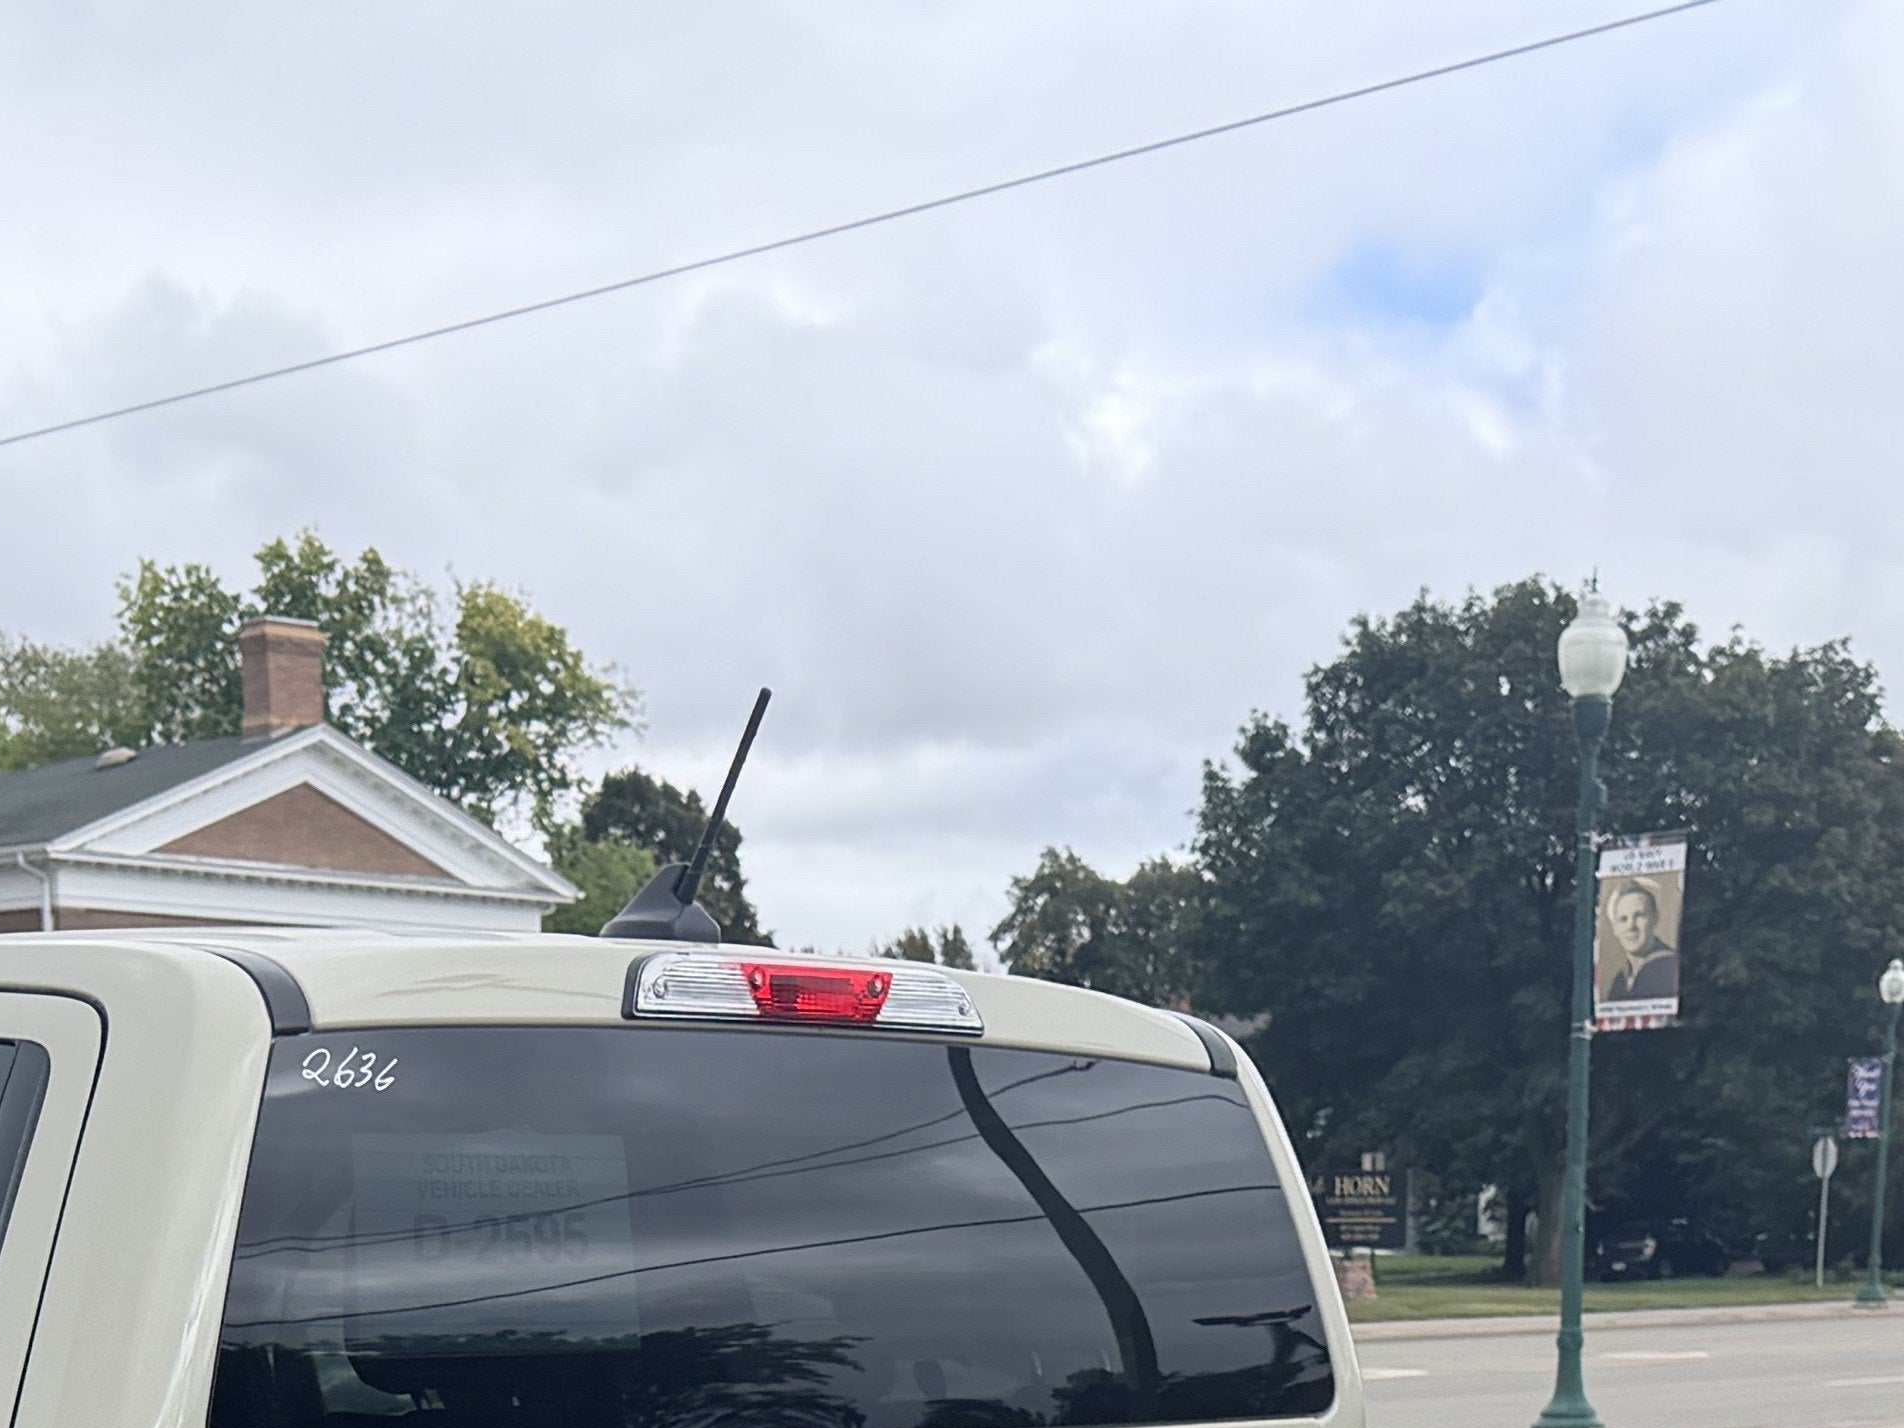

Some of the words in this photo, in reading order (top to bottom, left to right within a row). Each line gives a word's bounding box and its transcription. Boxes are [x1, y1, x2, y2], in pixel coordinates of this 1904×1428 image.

[302, 1047, 397, 1091] 2636
[416, 1179, 502, 1199] VEHICLE
[507, 1179, 581, 1199] DEALER
[1334, 1175, 1391, 1196] HORN
